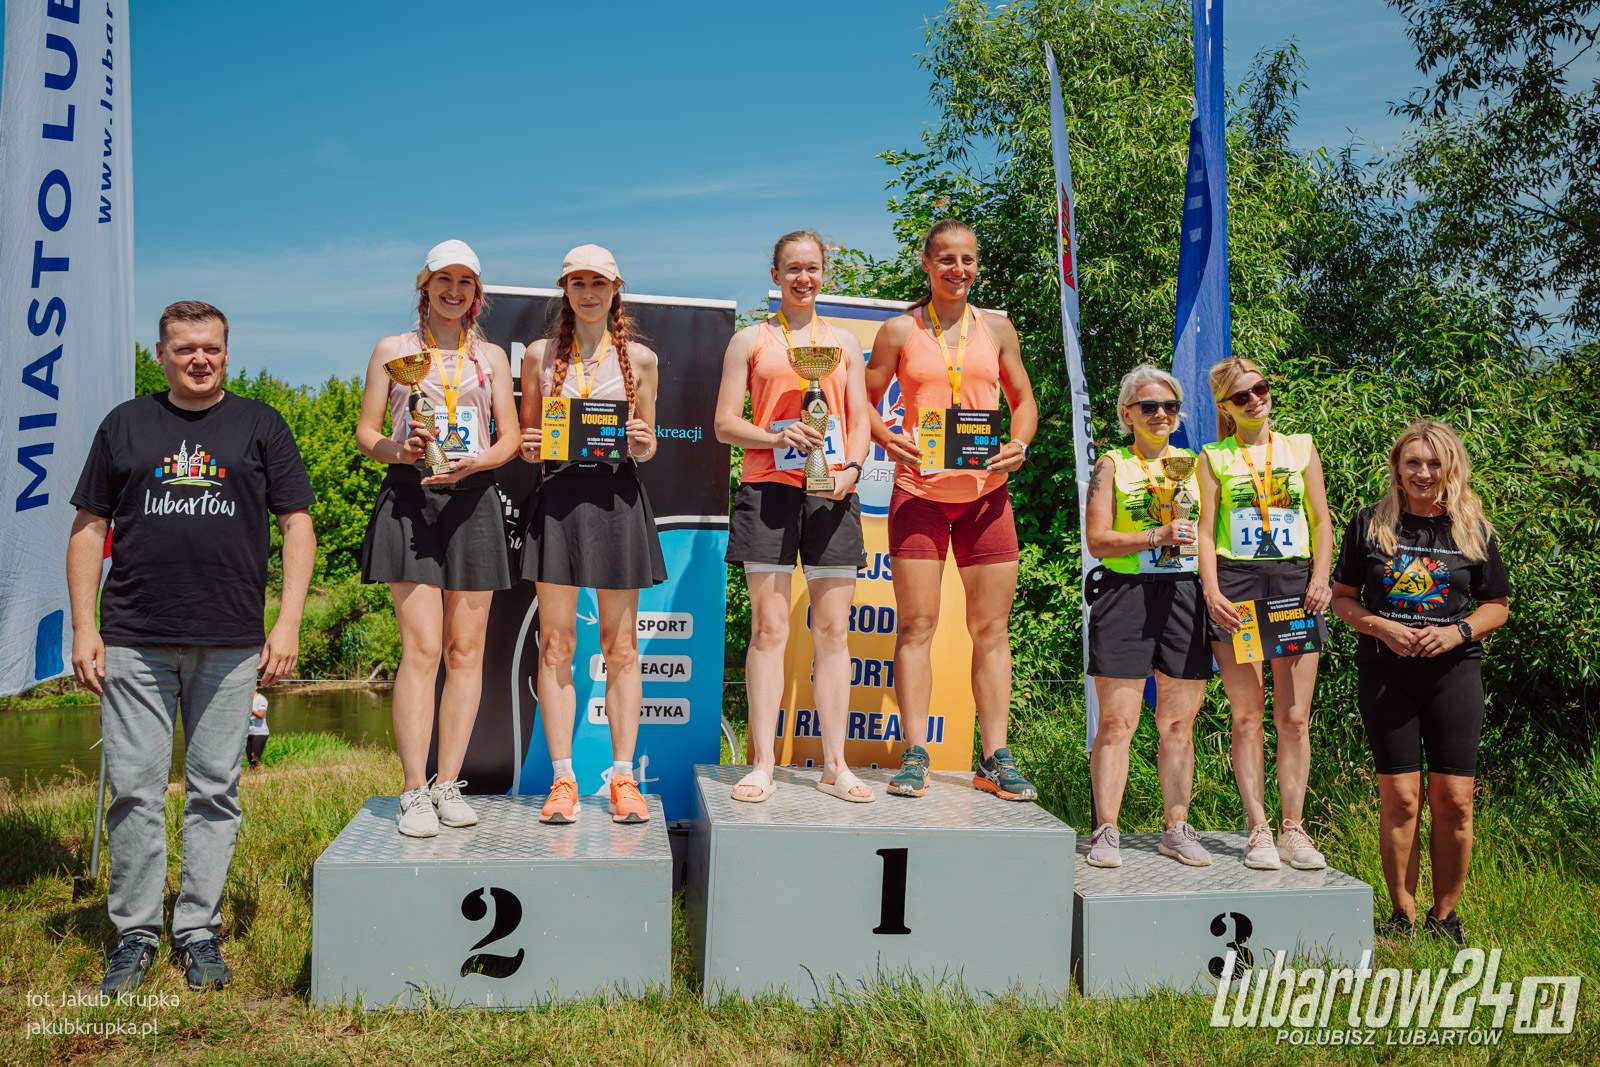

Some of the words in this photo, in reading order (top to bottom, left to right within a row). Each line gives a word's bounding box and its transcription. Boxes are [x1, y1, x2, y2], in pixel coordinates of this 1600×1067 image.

[16, 168, 72, 513] MIASTO
[581, 413, 618, 426] VOUCHER
[600, 426, 616, 437] 300
[655, 425, 702, 443] kreacji
[956, 423, 991, 435] VOUCHER
[974, 435, 989, 446] 500
[1267, 607, 1306, 623] VOUCHER
[638, 620, 687, 632] SPORT
[1289, 619, 1306, 631] 200
[872, 847, 912, 935] 1
[460, 886, 525, 979] 2
[1208, 911, 1254, 981] 3
